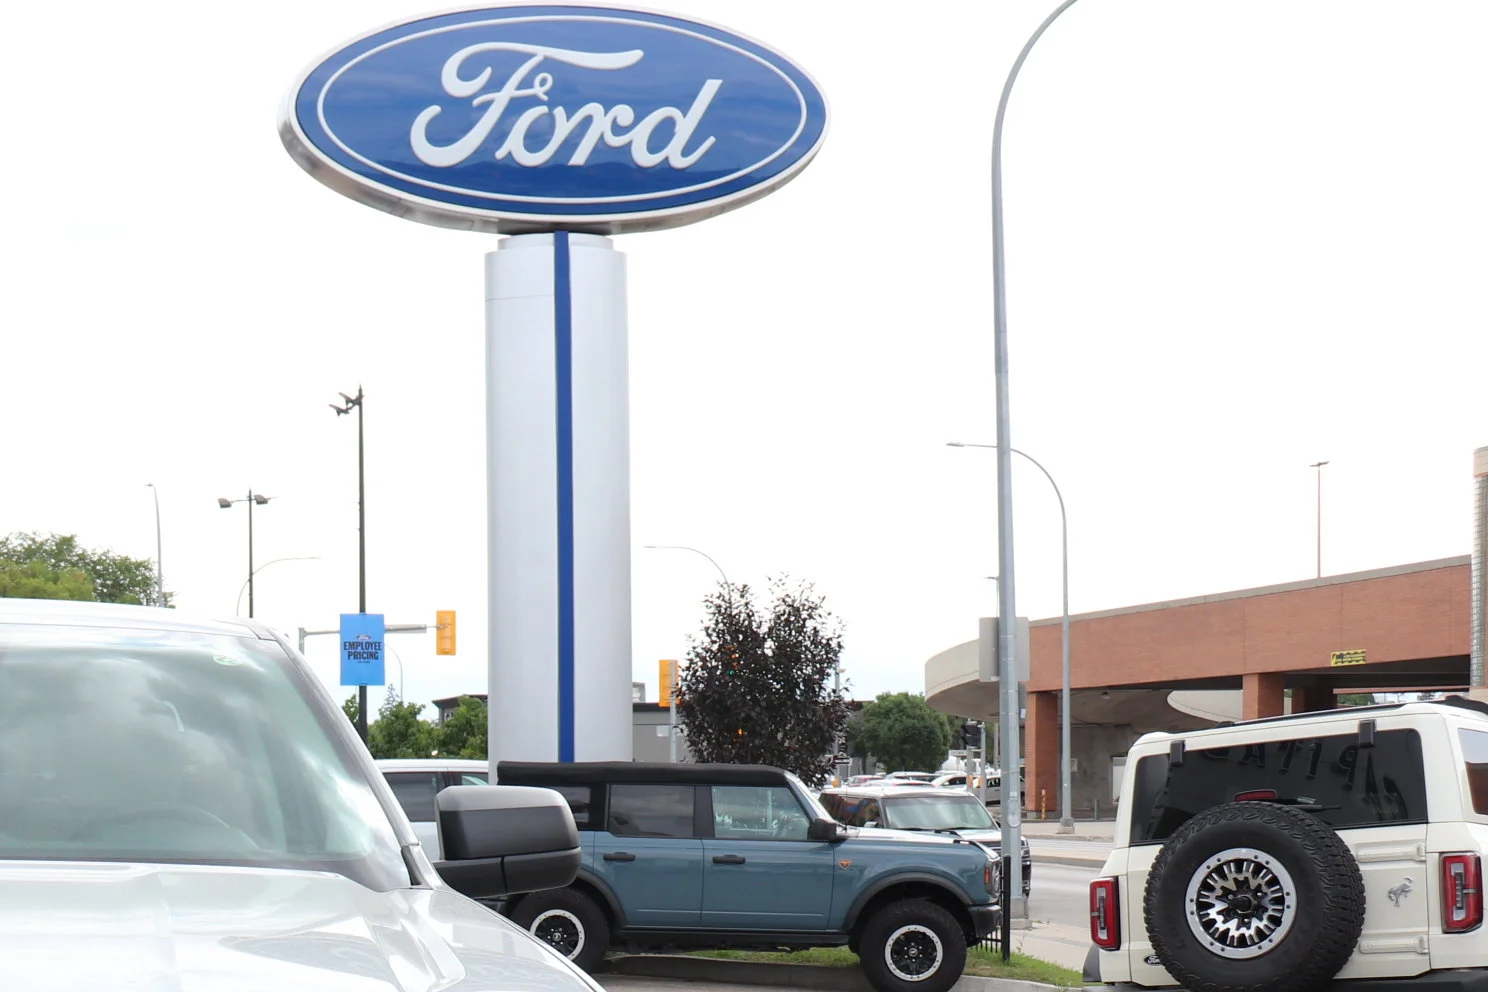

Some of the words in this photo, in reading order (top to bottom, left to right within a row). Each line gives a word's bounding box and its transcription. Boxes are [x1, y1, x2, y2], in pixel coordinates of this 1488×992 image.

[410, 41, 723, 168] Ford
[343, 641, 382, 651] EMPLOYEE
[347, 651, 379, 660] PRICING
